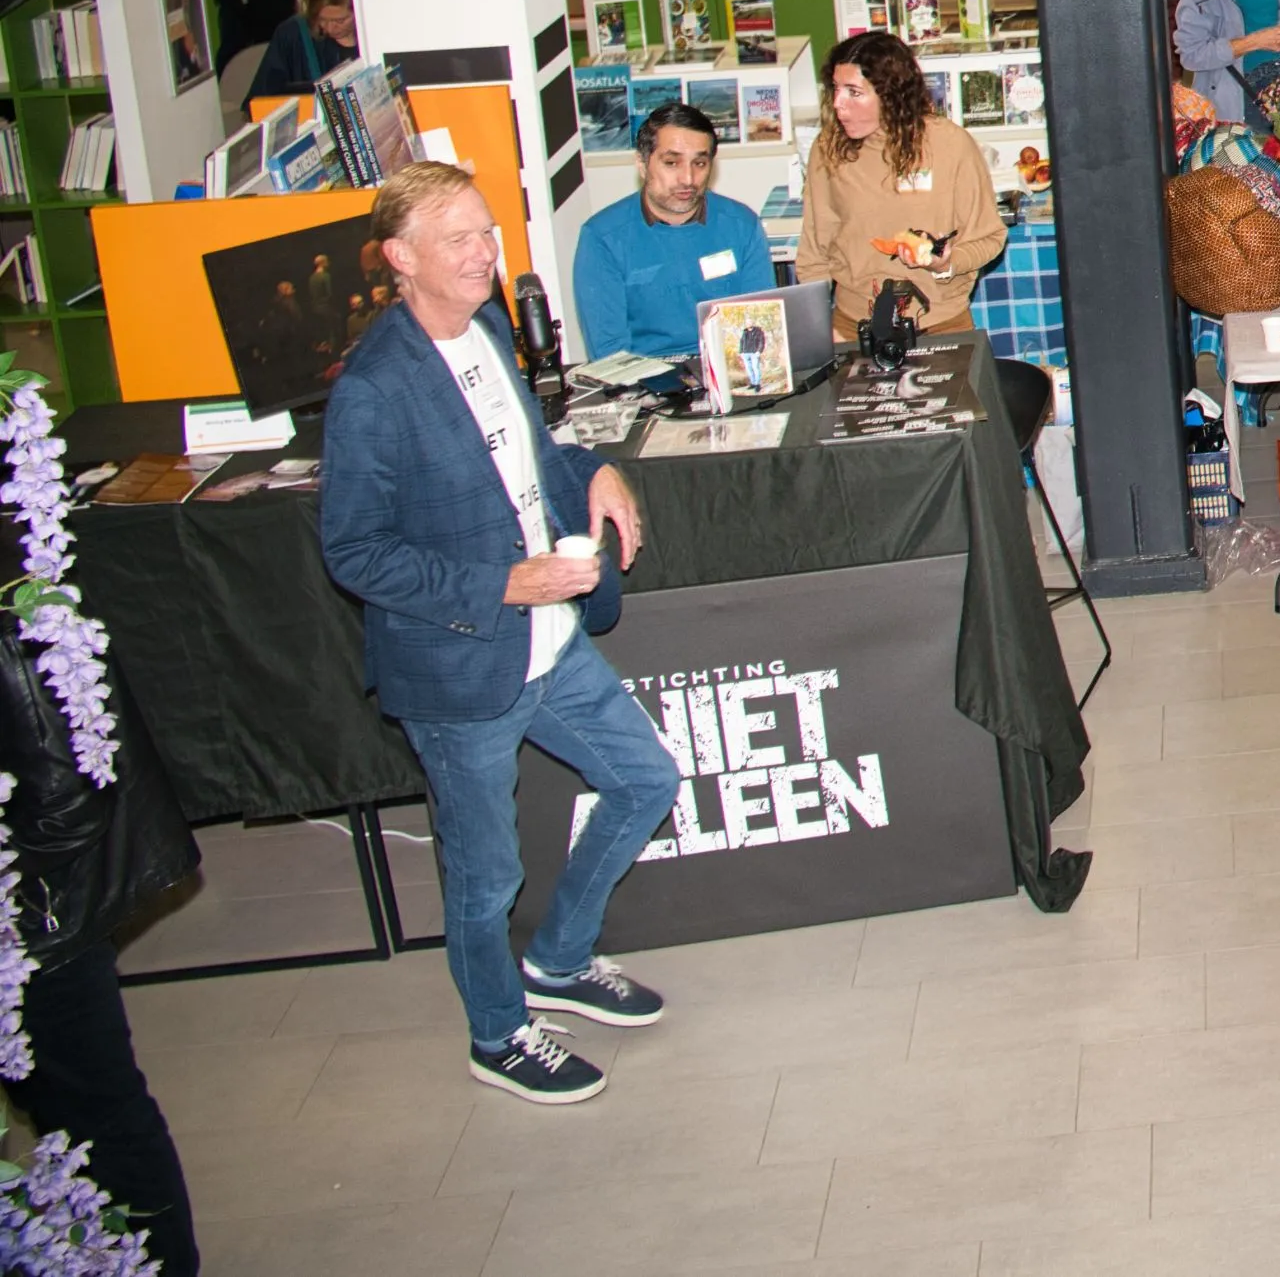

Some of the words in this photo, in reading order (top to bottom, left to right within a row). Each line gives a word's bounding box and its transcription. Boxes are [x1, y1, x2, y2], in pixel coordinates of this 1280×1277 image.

[575, 76, 628, 88] BOSATLAS
[755, 88, 779, 96] NEDER
[457, 364, 484, 392] IET
[487, 427, 508, 452] ET
[518, 483, 541, 512] TJE
[620, 659, 786, 694] STICHTING
[569, 753, 889, 862] LEEN
